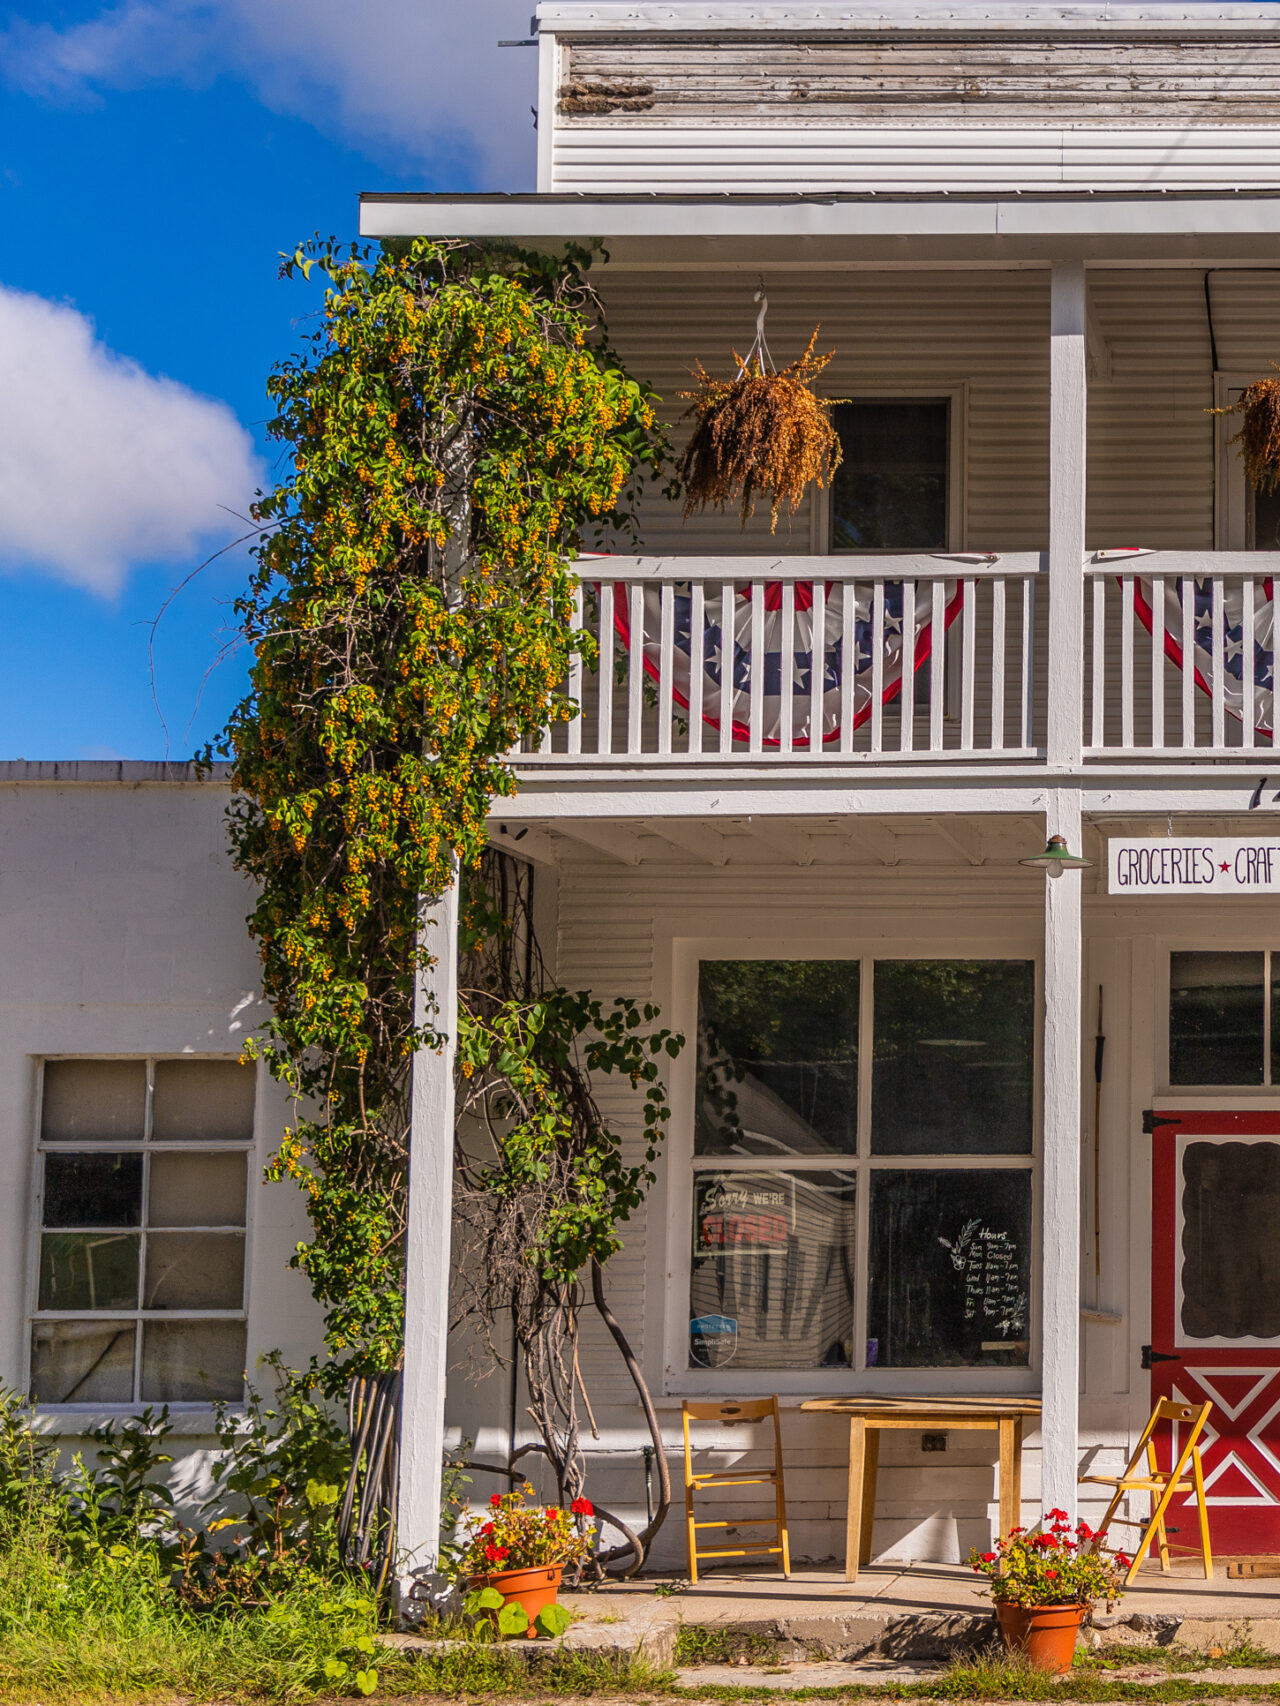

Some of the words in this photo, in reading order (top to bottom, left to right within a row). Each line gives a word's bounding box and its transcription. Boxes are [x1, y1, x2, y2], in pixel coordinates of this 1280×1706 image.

[1117, 847, 1215, 886] GROCERIES
[701, 1187, 748, 1212] Sorry
[753, 1192, 785, 1205] WE'RE
[702, 1215, 788, 1243] CLOSED
[978, 1227, 1008, 1240] Hours
[986, 1251, 1013, 1260] Closed
